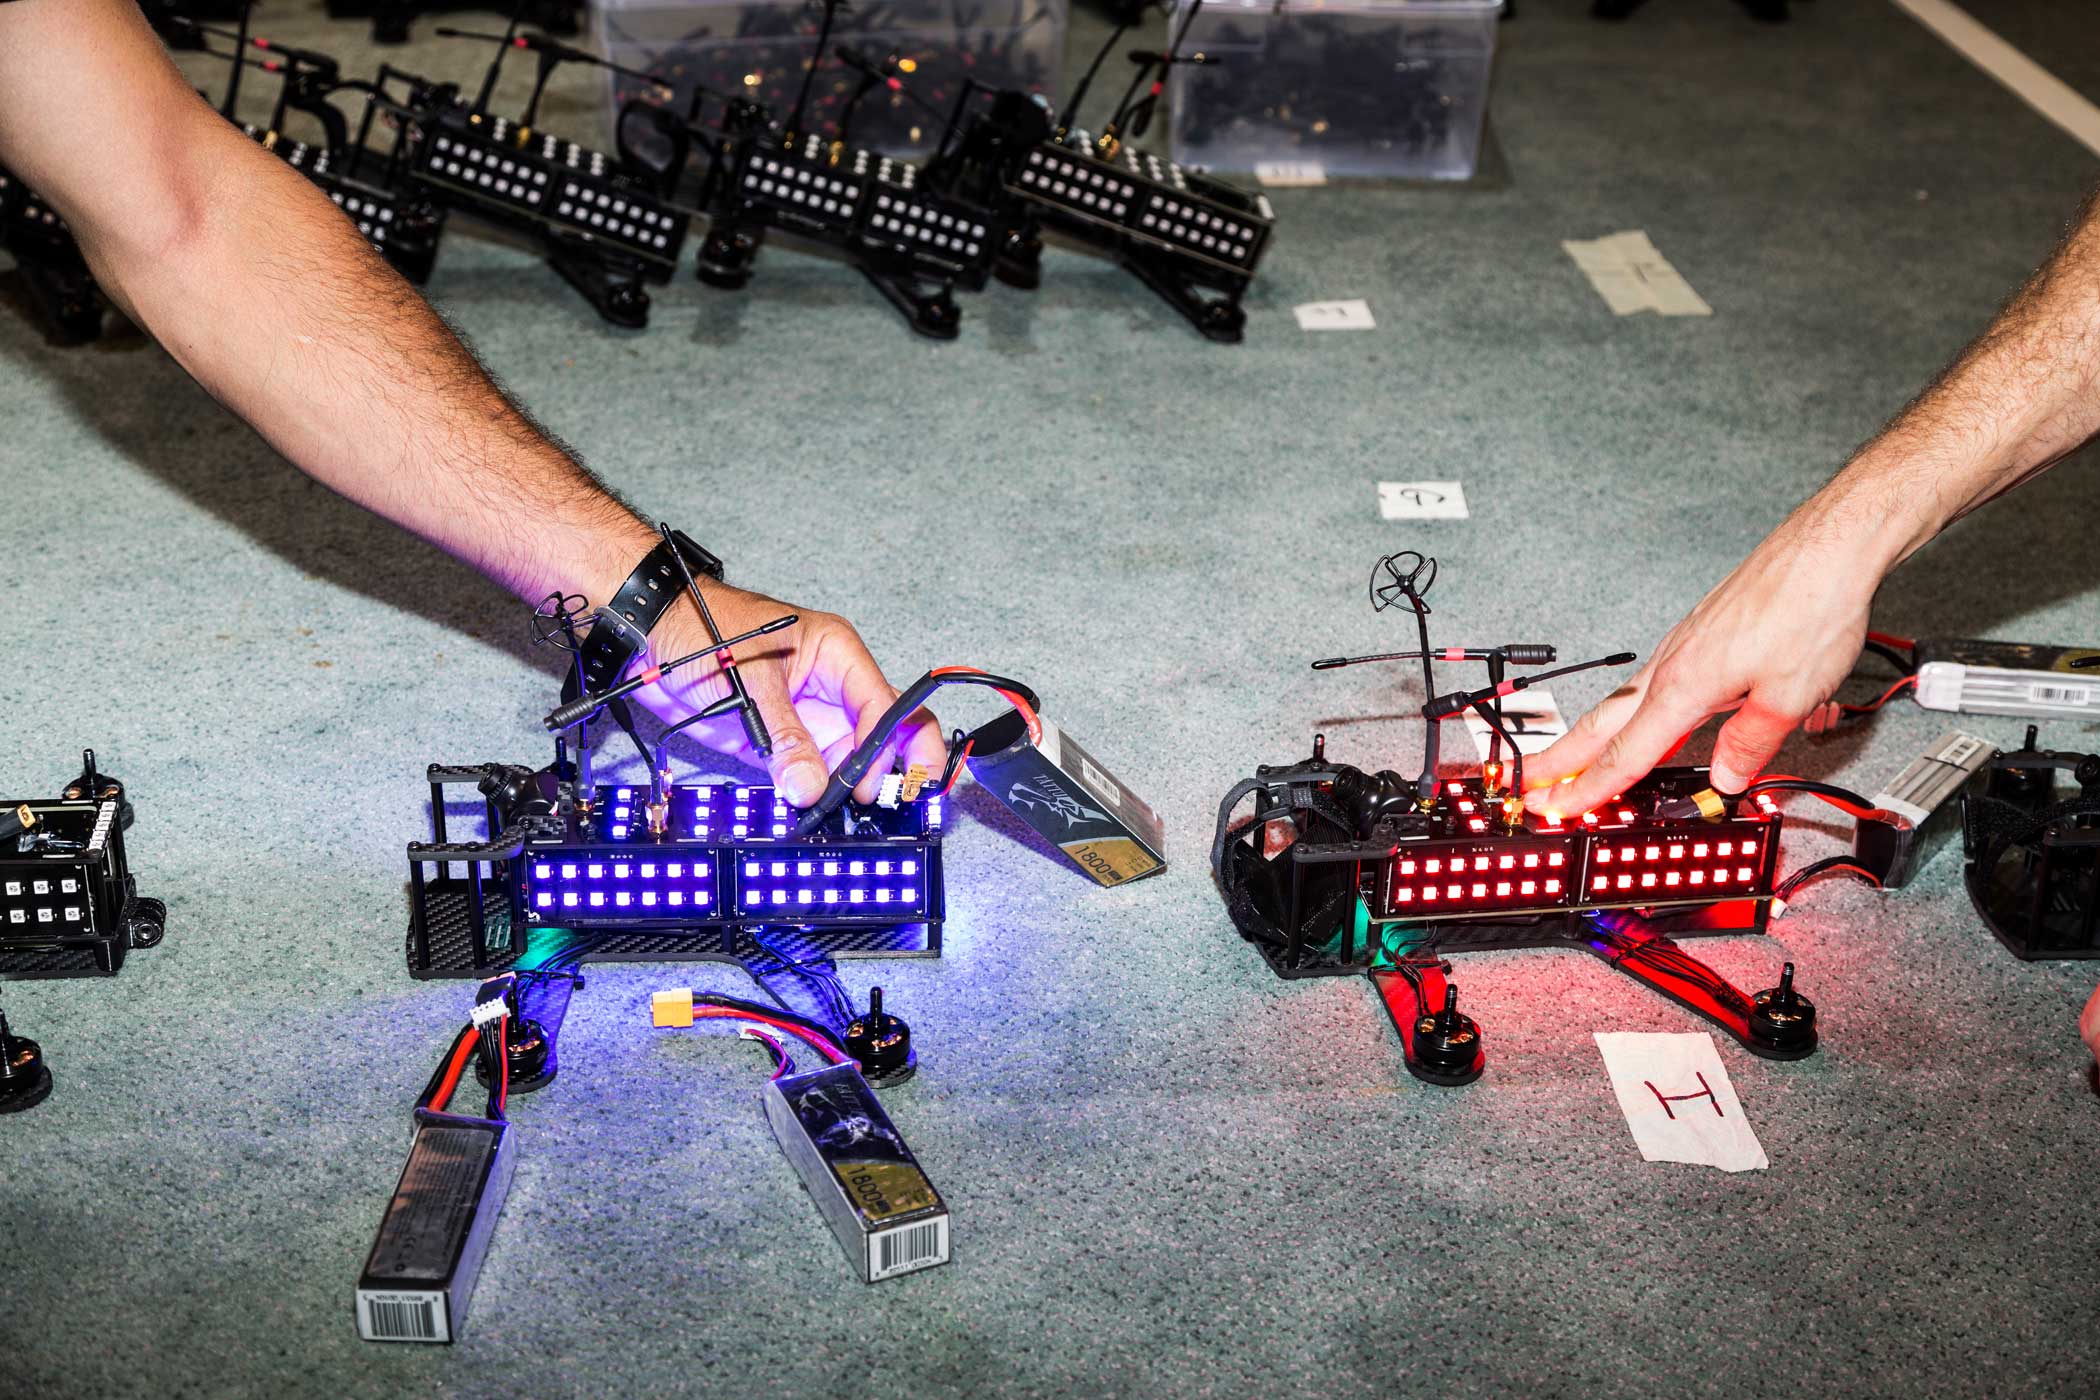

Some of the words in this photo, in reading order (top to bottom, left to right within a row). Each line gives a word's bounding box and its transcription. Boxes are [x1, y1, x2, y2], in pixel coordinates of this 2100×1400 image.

[1074, 845, 1111, 875] 1800
[1644, 1072, 1724, 1120] H
[848, 1166, 882, 1201] 1800
